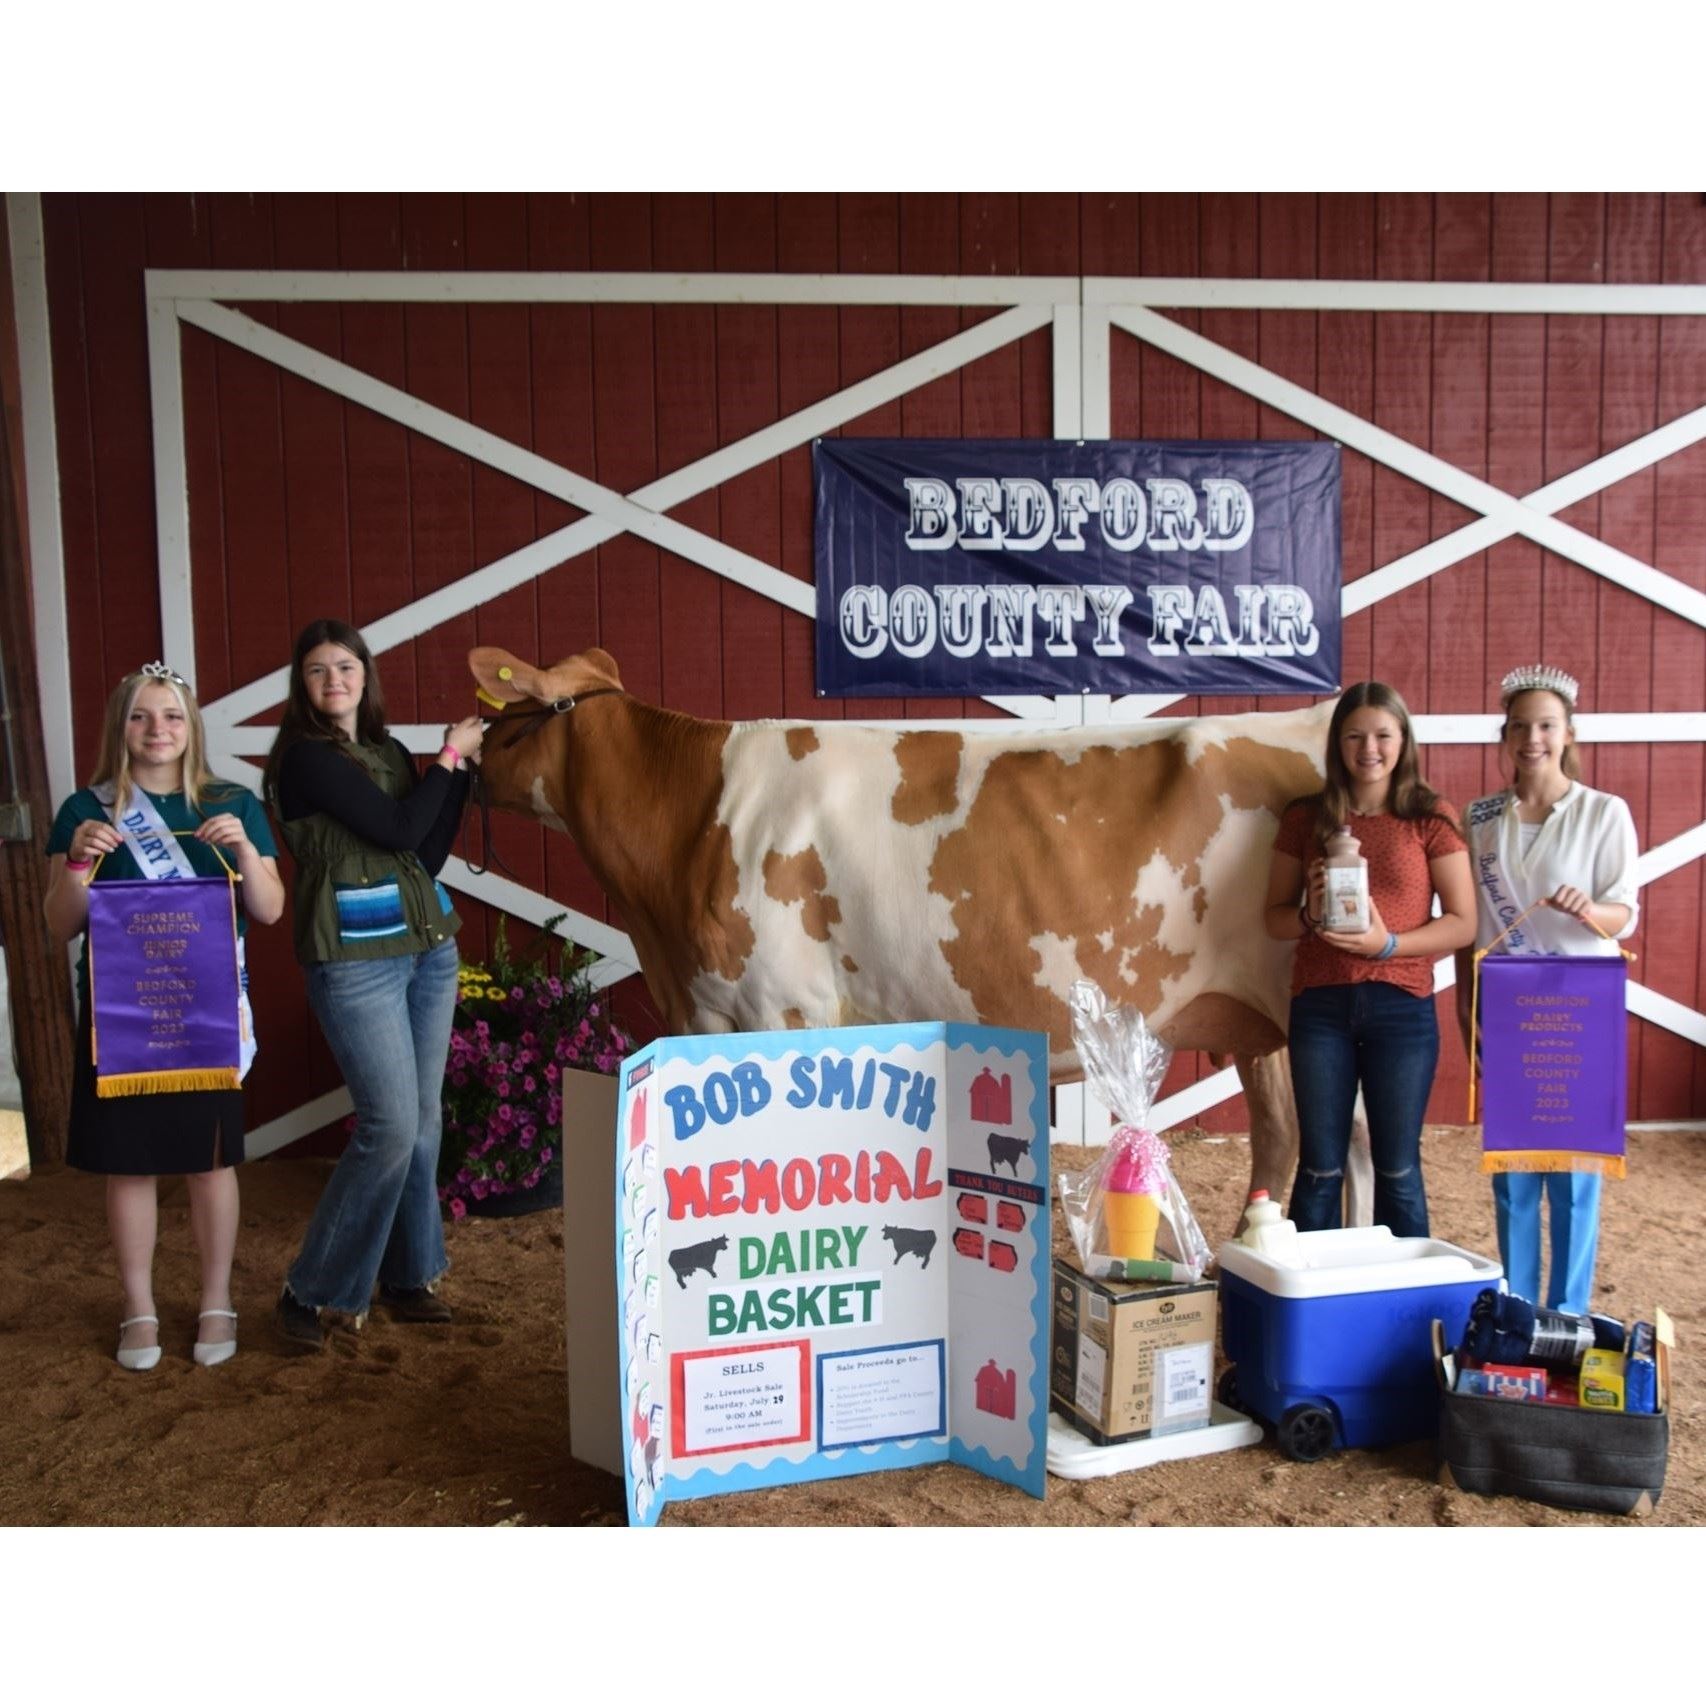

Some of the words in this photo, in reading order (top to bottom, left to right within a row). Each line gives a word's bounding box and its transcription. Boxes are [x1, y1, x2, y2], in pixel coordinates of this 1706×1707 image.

[904, 478, 1254, 551] BEDFORD
[840, 584, 1133, 659] COUNTY
[1148, 584, 1319, 658] FAIR
[122, 810, 171, 865] DAIRY
[1480, 852, 1506, 904] Bedford
[133, 911, 194, 923] SUPREME
[127, 923, 201, 935] CHAMPION
[143, 939, 187, 950] JUNIOR
[145, 949, 184, 959] DAIRY
[136, 980, 197, 992] BEDFORD
[139, 994, 194, 1006] COUNTY
[1516, 995, 1590, 1007] CHAMPION
[152, 1009, 182, 1019] FAIR
[1532, 1012, 1571, 1022] DAIRY
[1520, 1022, 1584, 1032] PRODUCTS
[1522, 1053, 1582, 1065] BEDFORD
[1524, 1067, 1580, 1079] COUNTY
[1536, 1083, 1568, 1093] FAIR
[664, 1060, 772, 1141] BOB
[786, 1055, 937, 1132] SMITH
[664, 1147, 943, 1221] MEMORIAL
[955, 1172, 983, 1188] THANK
[988, 1178, 1003, 1193] YOU
[738, 1225, 869, 1280] DAIRY
[708, 1280, 881, 1336] BASKET
[1132, 1320, 1144, 1328] ICE
[1146, 1315, 1173, 1327] CREAM
[1174, 1311, 1202, 1321] MAKER
[722, 1362, 765, 1376] SELLS
[836, 1363, 854, 1372] Sale
[857, 1358, 894, 1369] Proceeds
[896, 1357, 907, 1365] go
[703, 1391, 716, 1399] Jr.
[719, 1385, 762, 1398] Livestock
[764, 1383, 783, 1392] Sale
[749, 1397, 769, 1406] July
[725, 1412, 746, 1420] 9:00
[748, 1410, 763, 1418] AM
